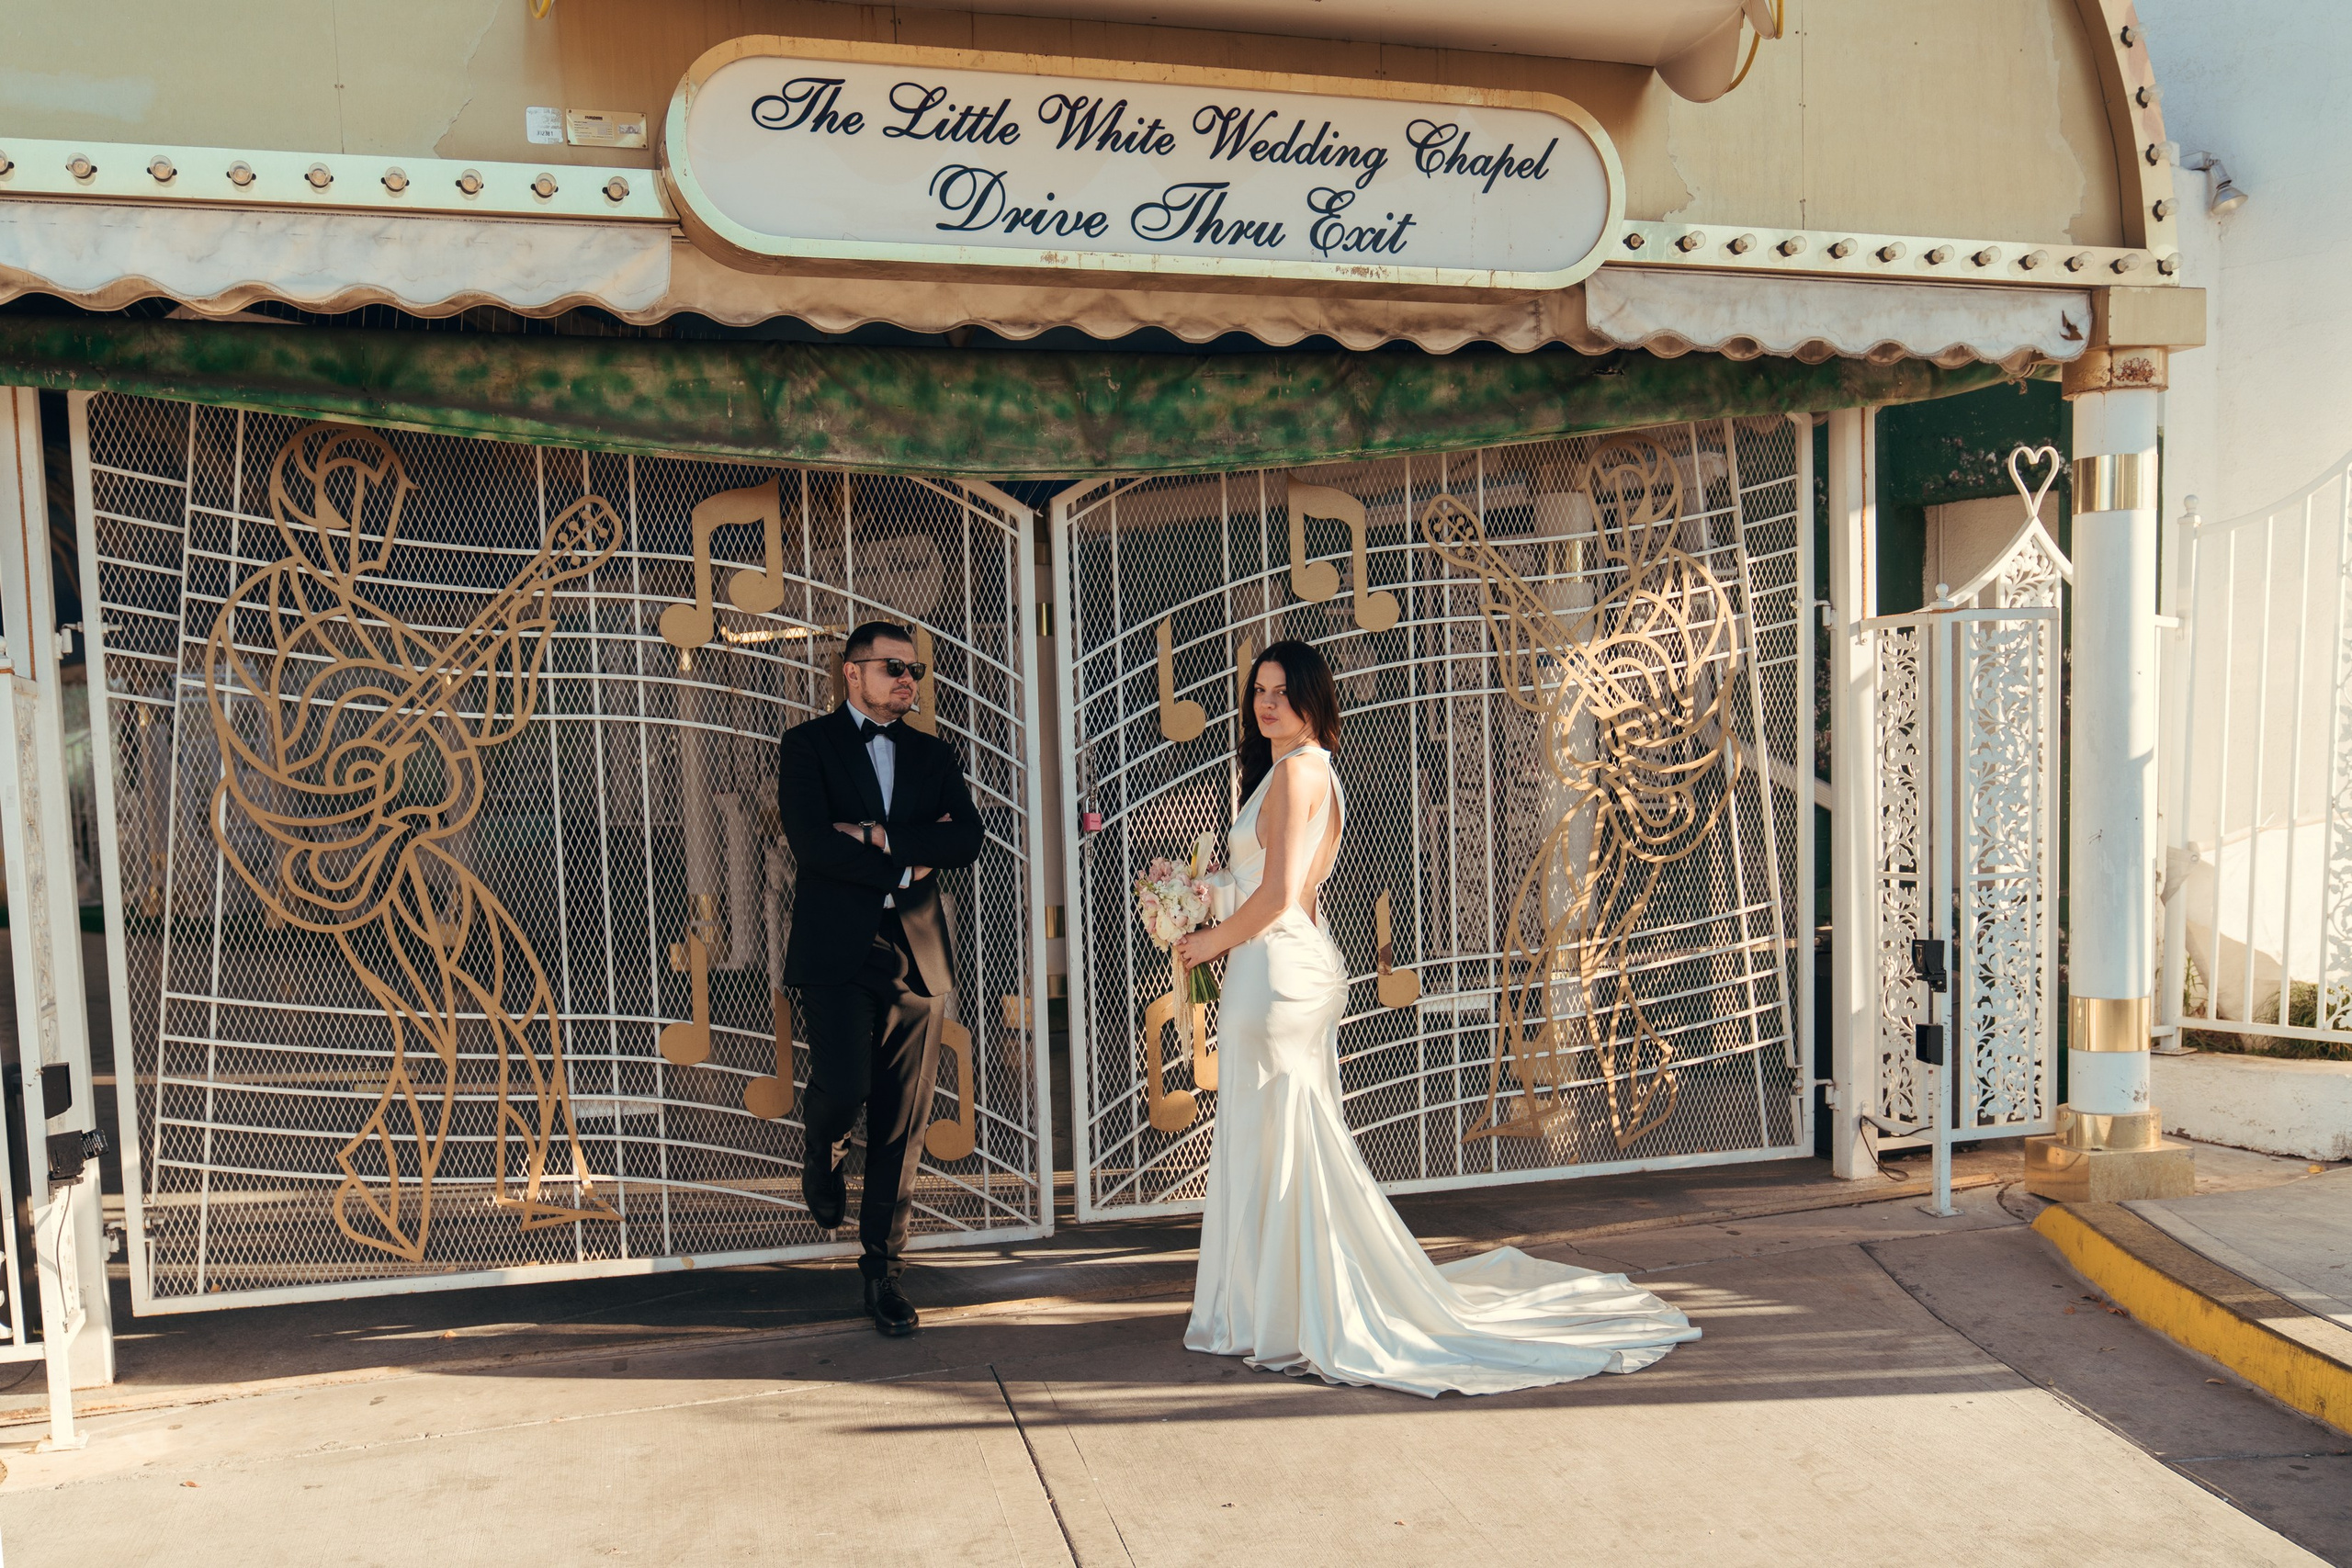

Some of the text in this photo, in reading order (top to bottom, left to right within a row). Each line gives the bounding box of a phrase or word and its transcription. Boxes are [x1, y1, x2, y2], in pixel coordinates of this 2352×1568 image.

[751, 77, 1559, 194] The Little White Wedding Chapel
[928, 164, 1417, 258] Drive Thru Exit
